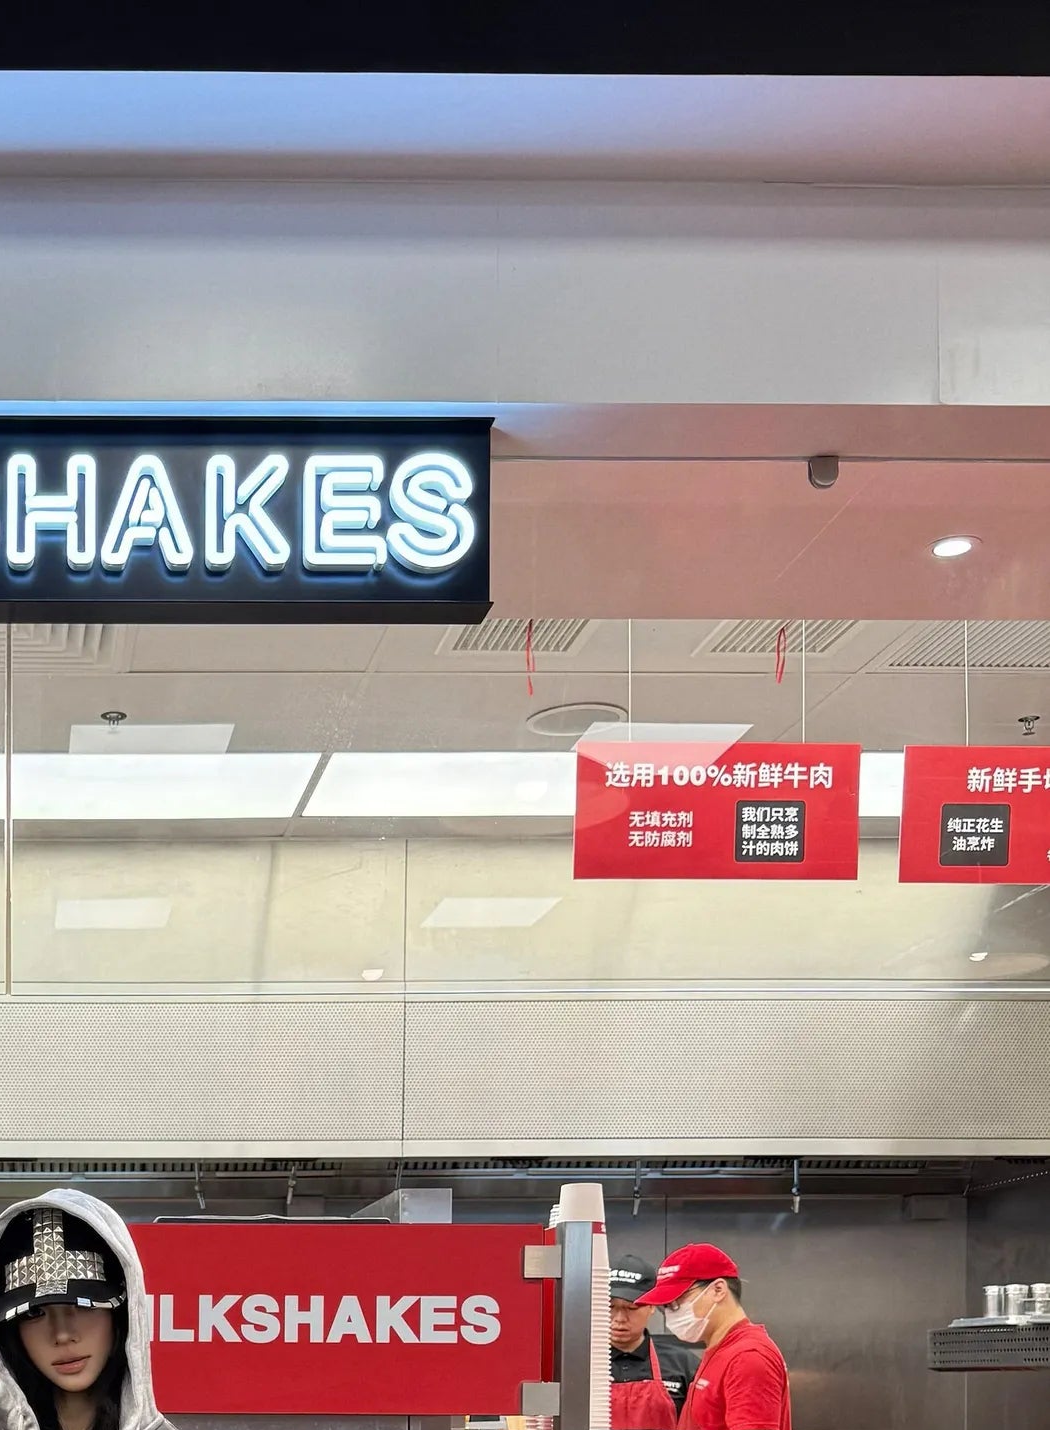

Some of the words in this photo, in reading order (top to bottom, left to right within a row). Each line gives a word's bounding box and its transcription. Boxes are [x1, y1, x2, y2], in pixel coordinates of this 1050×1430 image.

[605, 762, 833, 789] 选用100%新鲜牛肉
[967, 766, 1050, 793] 新鲜手
[629, 811, 693, 828] 无填充剂
[742, 807, 799, 822] 我们只烹
[742, 824, 799, 840] 制全熟多
[947, 818, 1004, 833] 纯正花生
[629, 831, 692, 847] 无防腐剂
[952, 836, 995, 851] 油烹炸
[742, 840, 799, 856] 汁的肉饼
[145, 1294, 501, 1344] LKSHAKES
